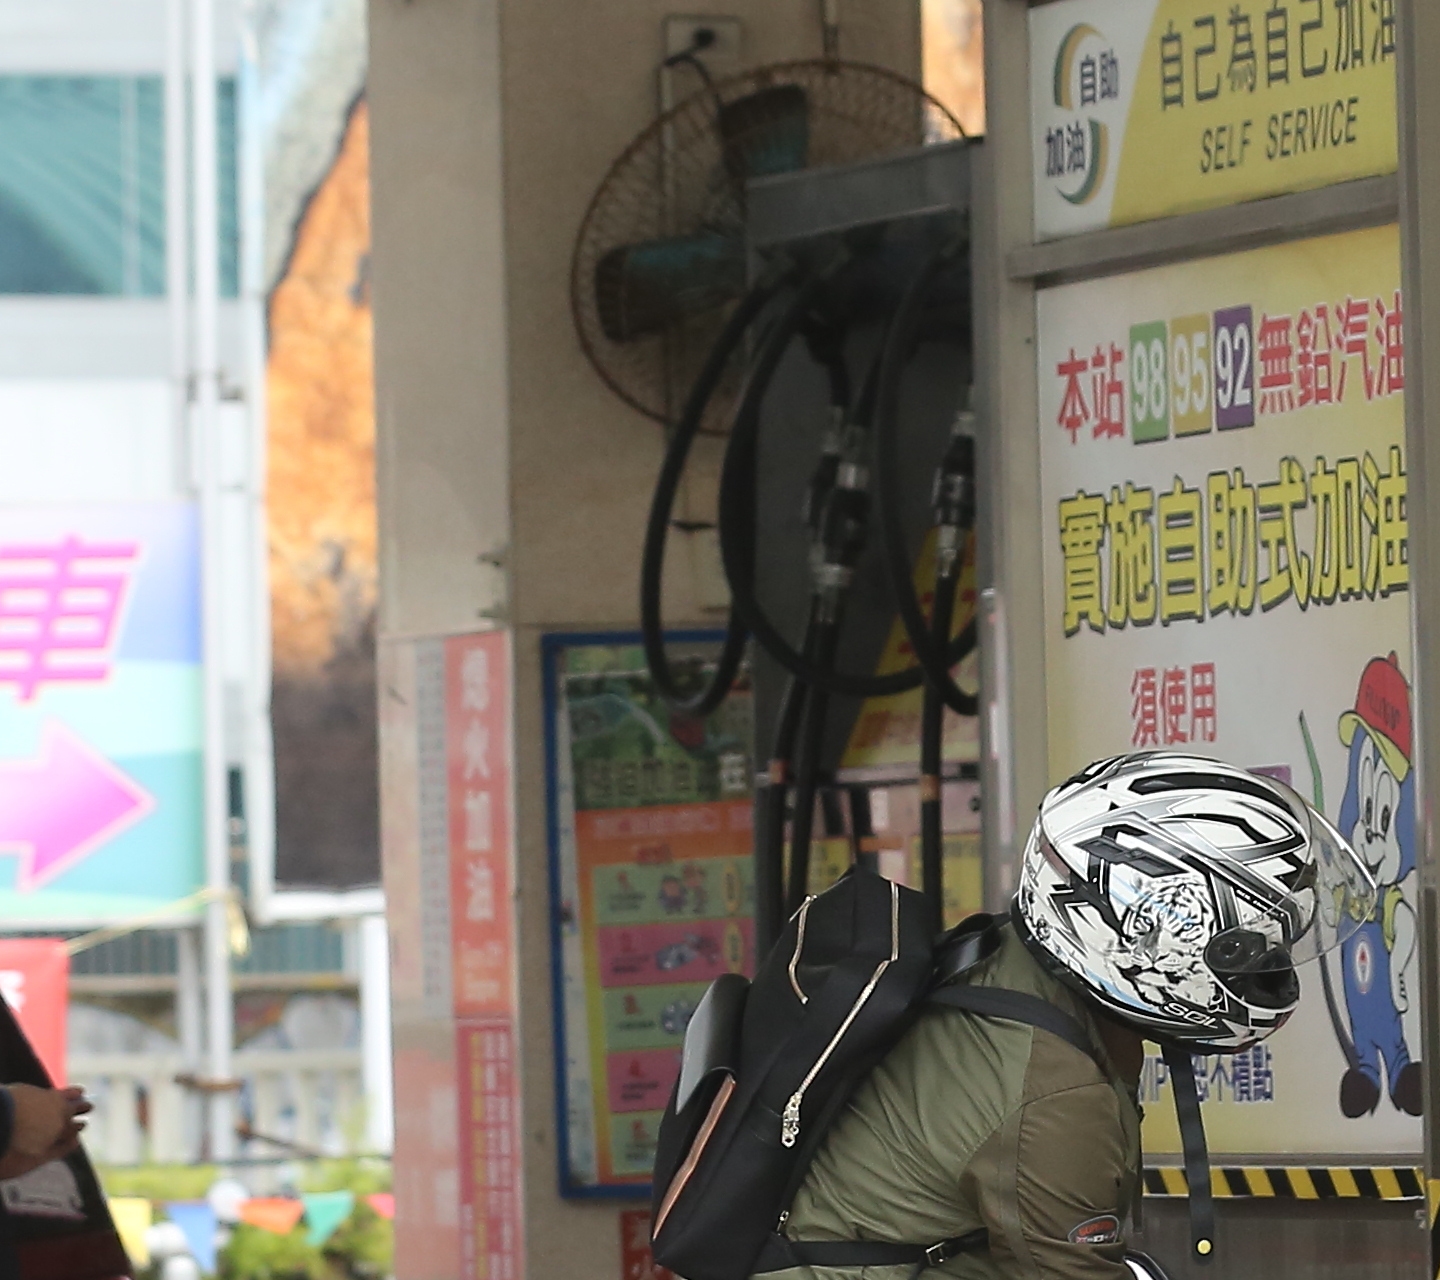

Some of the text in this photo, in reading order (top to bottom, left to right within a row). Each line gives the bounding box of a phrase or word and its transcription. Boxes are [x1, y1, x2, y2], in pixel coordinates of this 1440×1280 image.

[1078, 49, 1119, 106] 自助
[1045, 117, 1087, 178] 加油
[1201, 95, 1359, 174] SELF SERVICE
[1057, 290, 1404, 444] 本站 98 95 92 無鉛汽油
[1059, 445, 1408, 637] 實施自助式加油
[1131, 662, 1216, 747] 須使用
[1163, 1001, 1218, 1028] SOL
